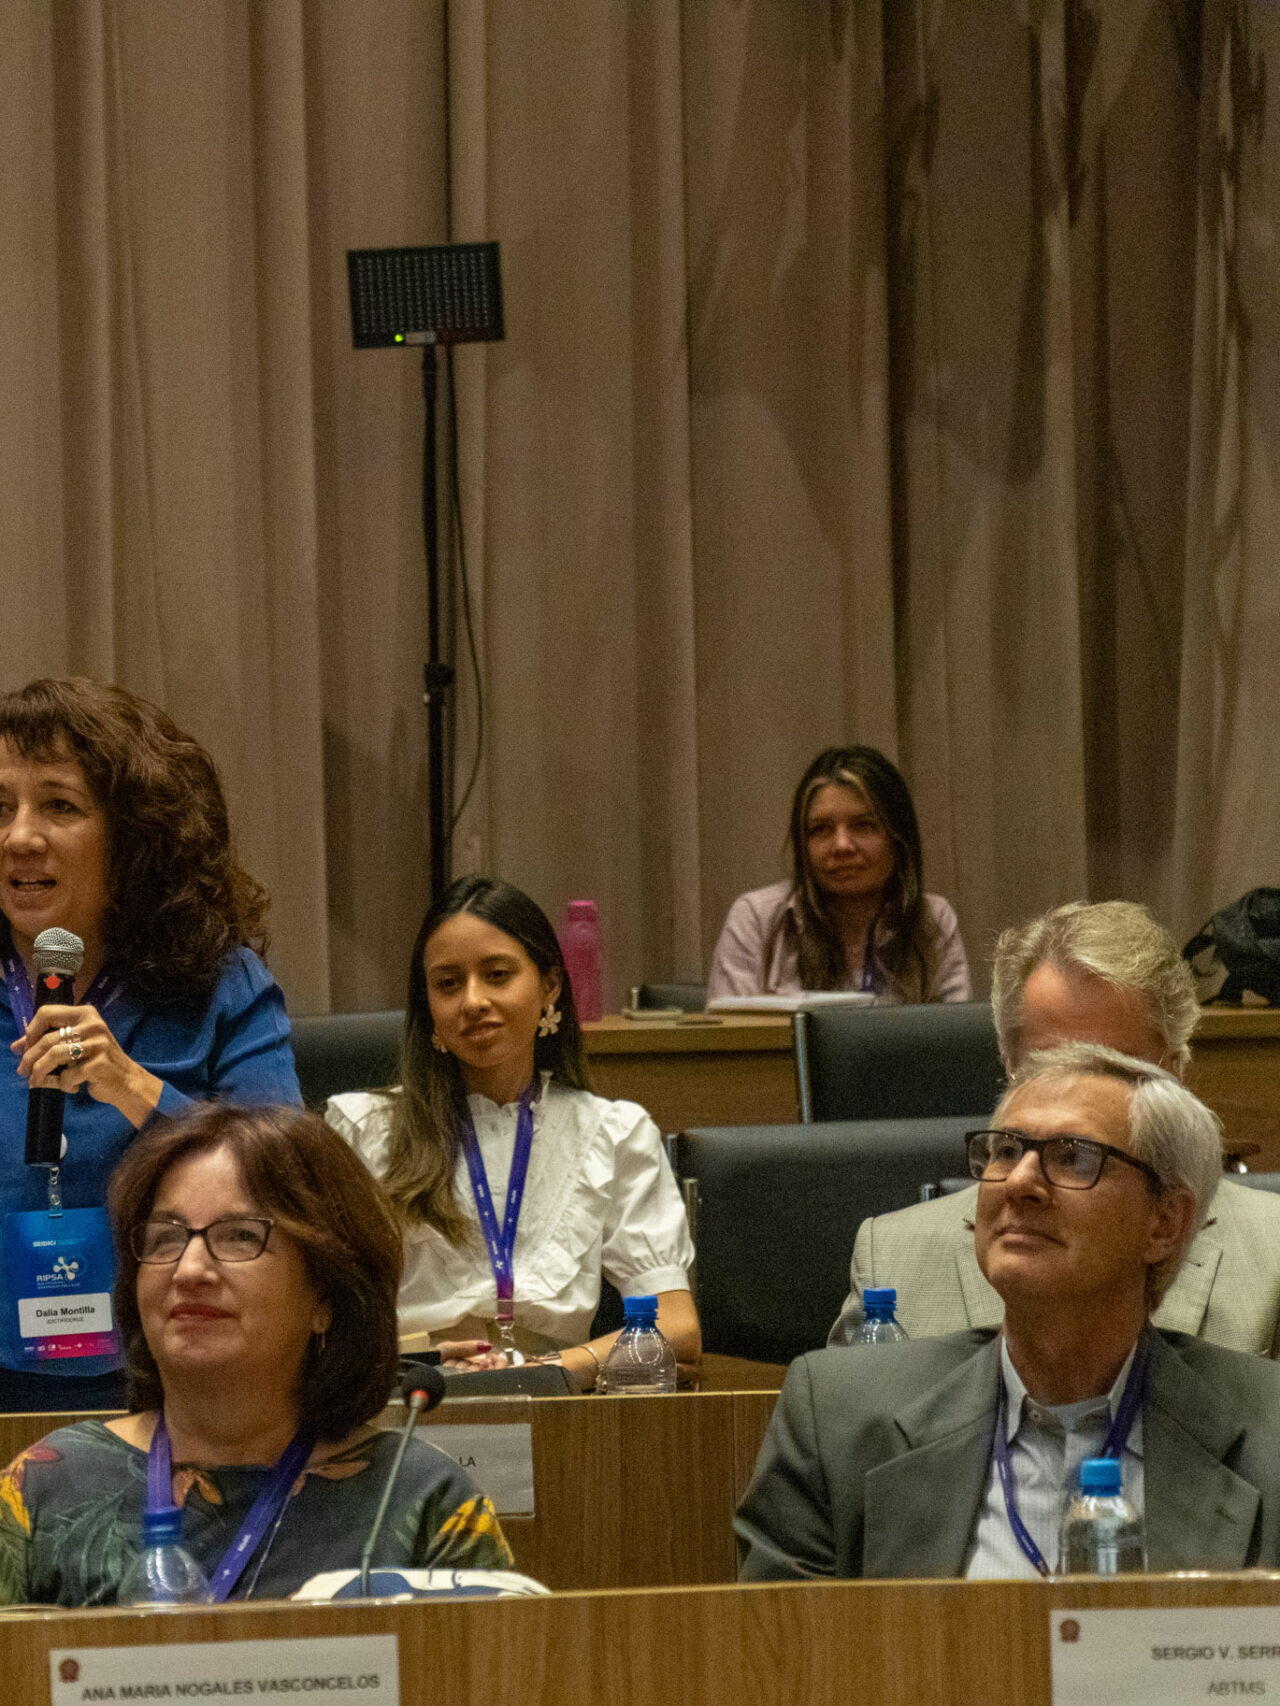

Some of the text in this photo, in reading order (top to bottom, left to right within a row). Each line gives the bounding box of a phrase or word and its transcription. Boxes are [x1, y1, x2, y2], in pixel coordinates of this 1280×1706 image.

[36, 1274, 63, 1282] RIPSA
[36, 1306, 95, 1318] Dalia Montilla
[1151, 1646, 1215, 1661] SERGIO
[82, 1674, 380, 1701] ANA MARIA NOGALES VASCONCELOS
